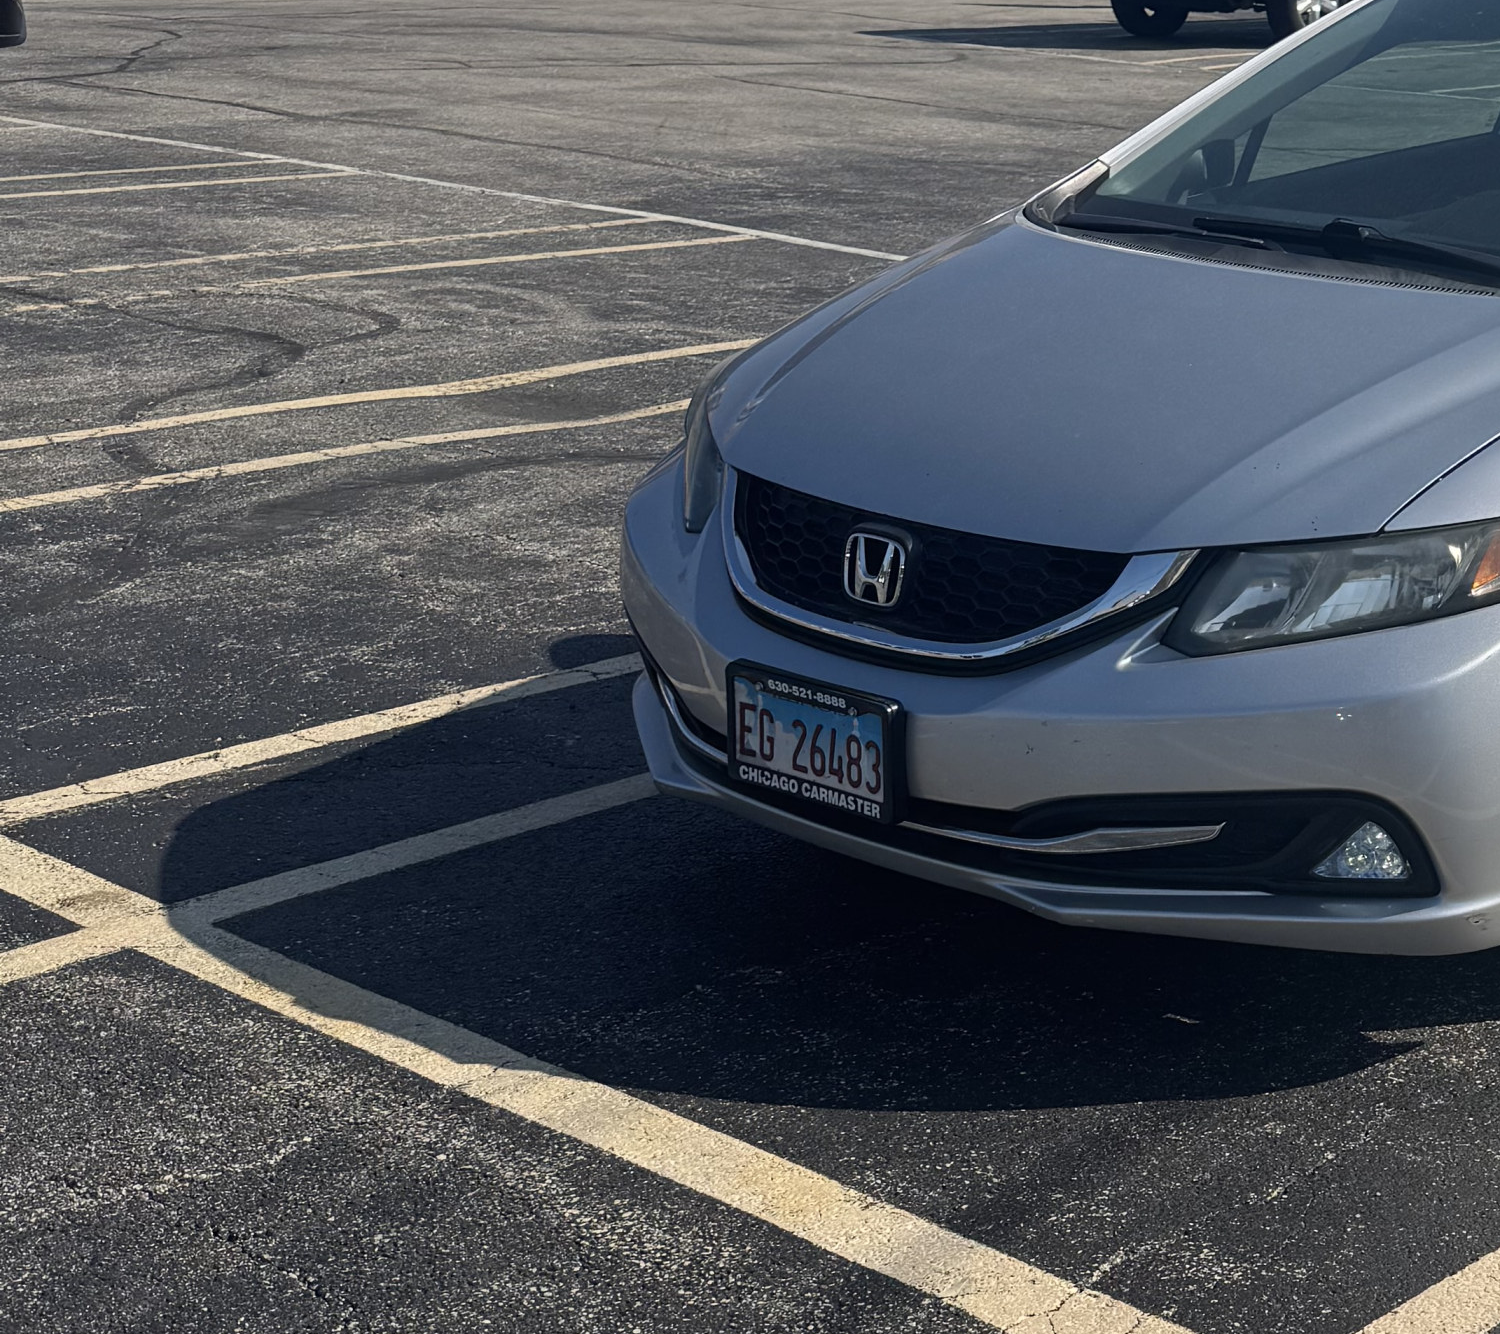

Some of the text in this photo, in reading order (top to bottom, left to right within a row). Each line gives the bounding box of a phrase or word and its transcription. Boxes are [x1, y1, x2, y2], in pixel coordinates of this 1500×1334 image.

[767, 678, 847, 709] 630-521-8888
[738, 701, 882, 795] EG 26483
[738, 765, 881, 819] CHICAGO CARMASTER
